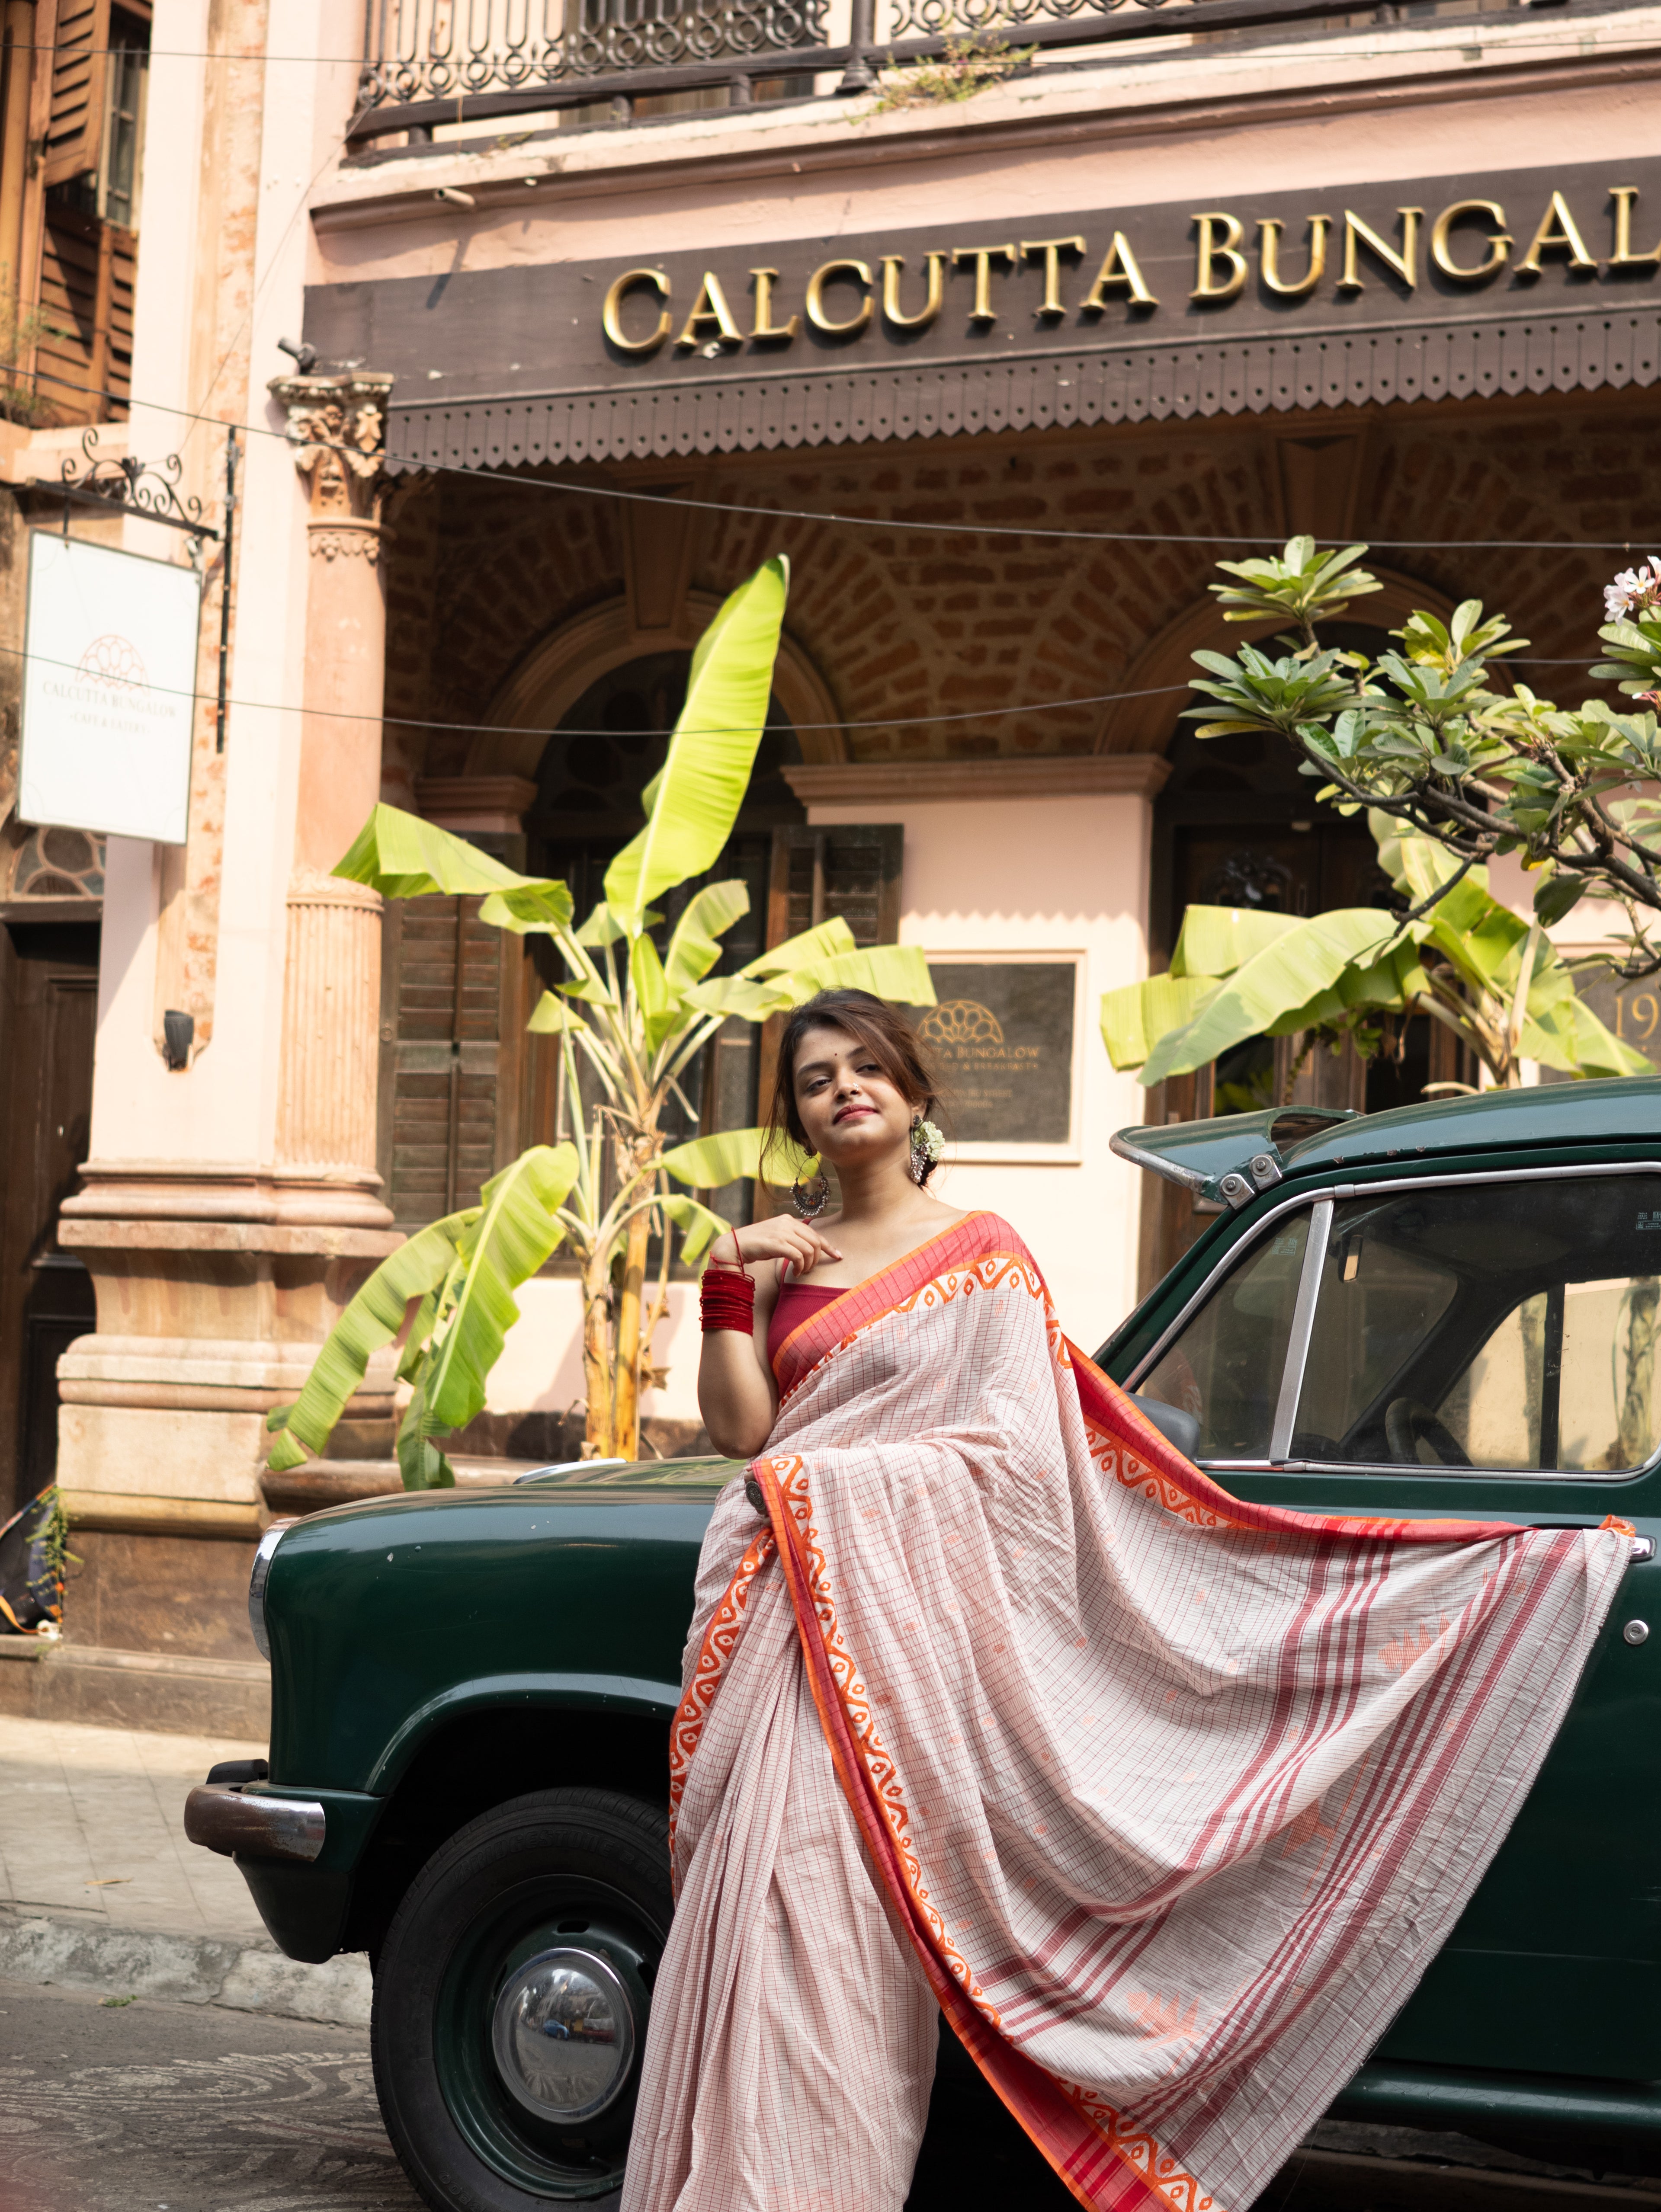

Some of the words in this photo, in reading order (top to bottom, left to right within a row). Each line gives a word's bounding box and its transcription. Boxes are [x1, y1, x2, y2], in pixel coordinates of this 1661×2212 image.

[603, 230, 1160, 352] CALCUTTA
[1188, 185, 1661, 303] BUNGAL
[43, 681, 107, 706] CALCUTTA
[111, 694, 176, 717] BUNGALOW
[956, 1046, 1039, 1059] BUNGALOW
[963, 1062, 970, 1070] &
[974, 1062, 1031, 1070] BREAKFAST
[453, 1829, 615, 1889] BRIDGESTONE
